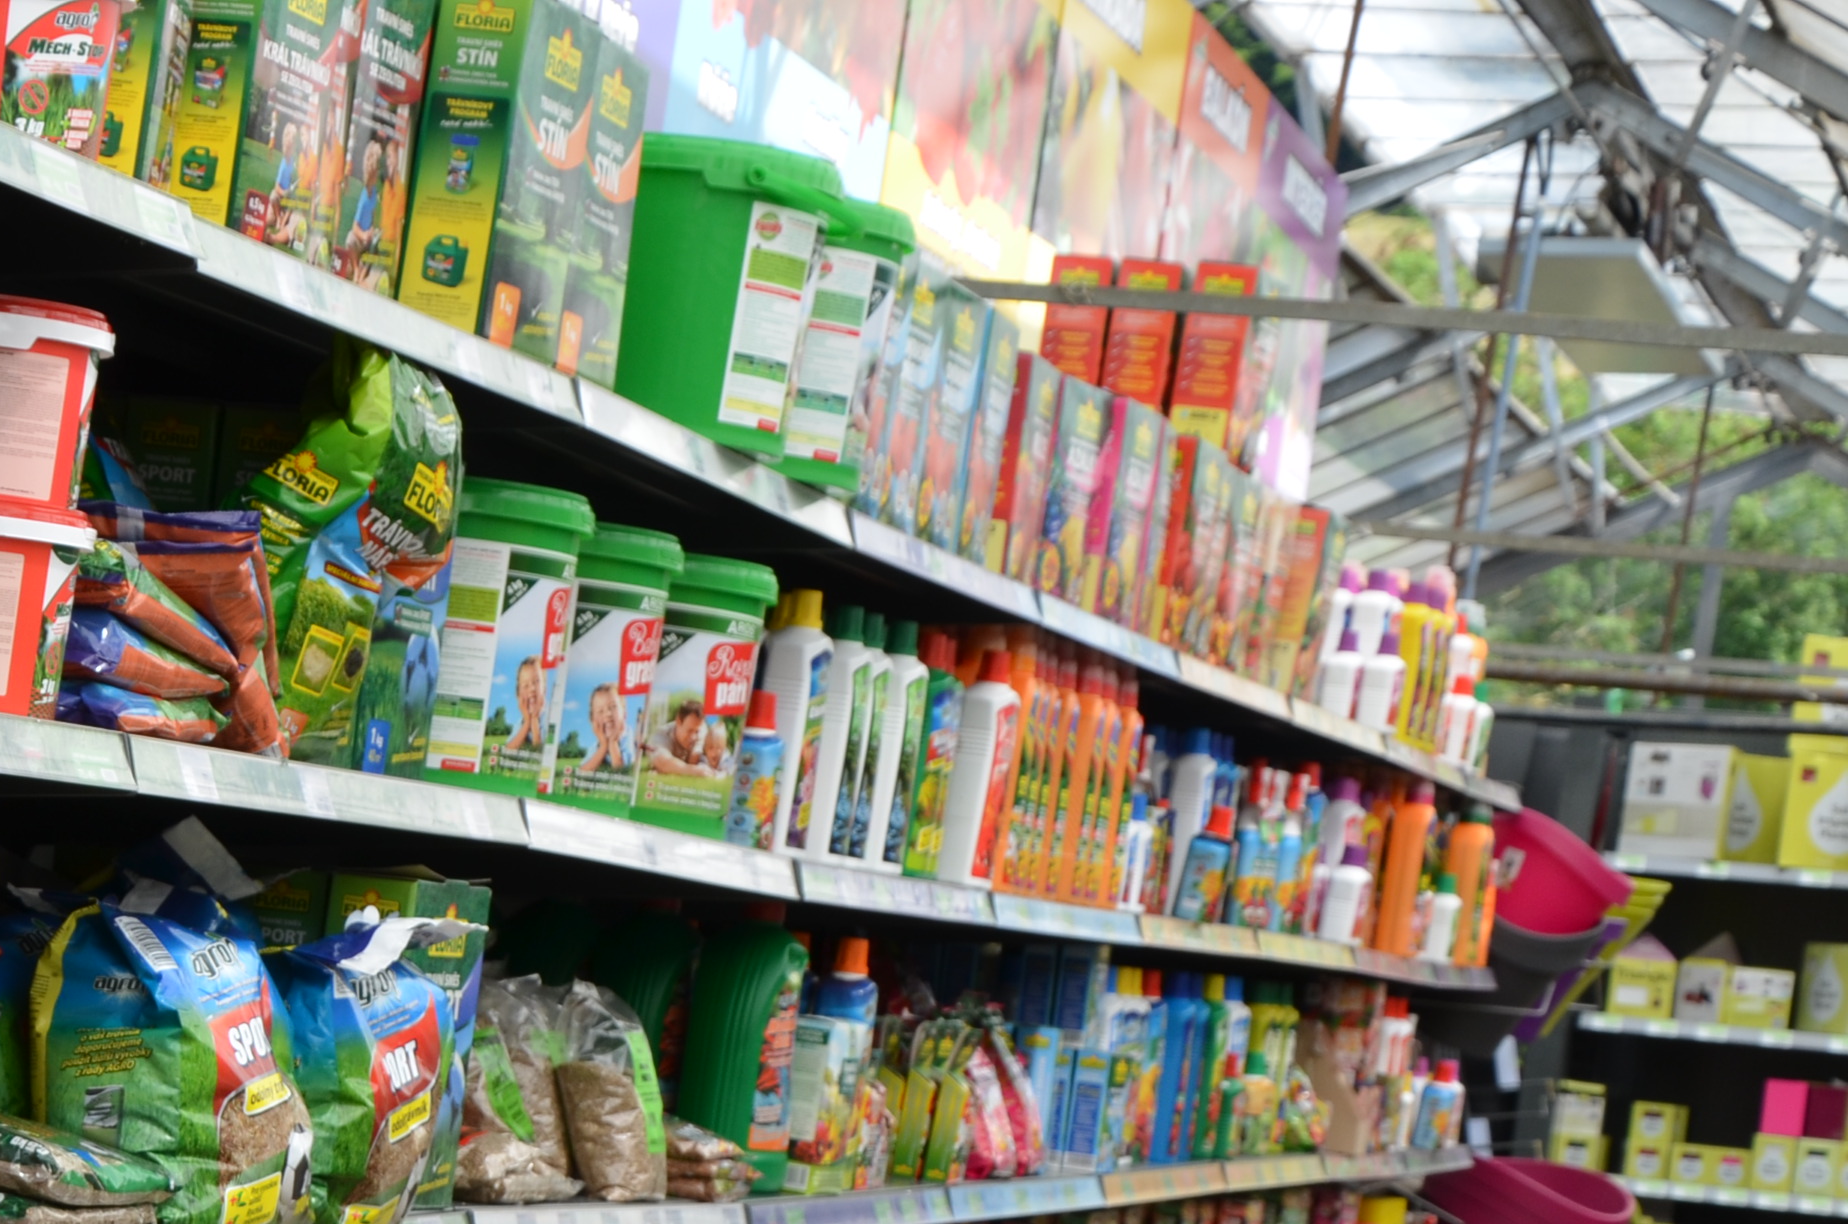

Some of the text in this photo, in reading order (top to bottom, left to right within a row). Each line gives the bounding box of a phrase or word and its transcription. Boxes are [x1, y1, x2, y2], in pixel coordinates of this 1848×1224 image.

[455, 10, 511, 31] FLORIA
[457, 47, 497, 67] STÍN
[537, 121, 570, 158] STÍN
[138, 462, 195, 483] SPORT
